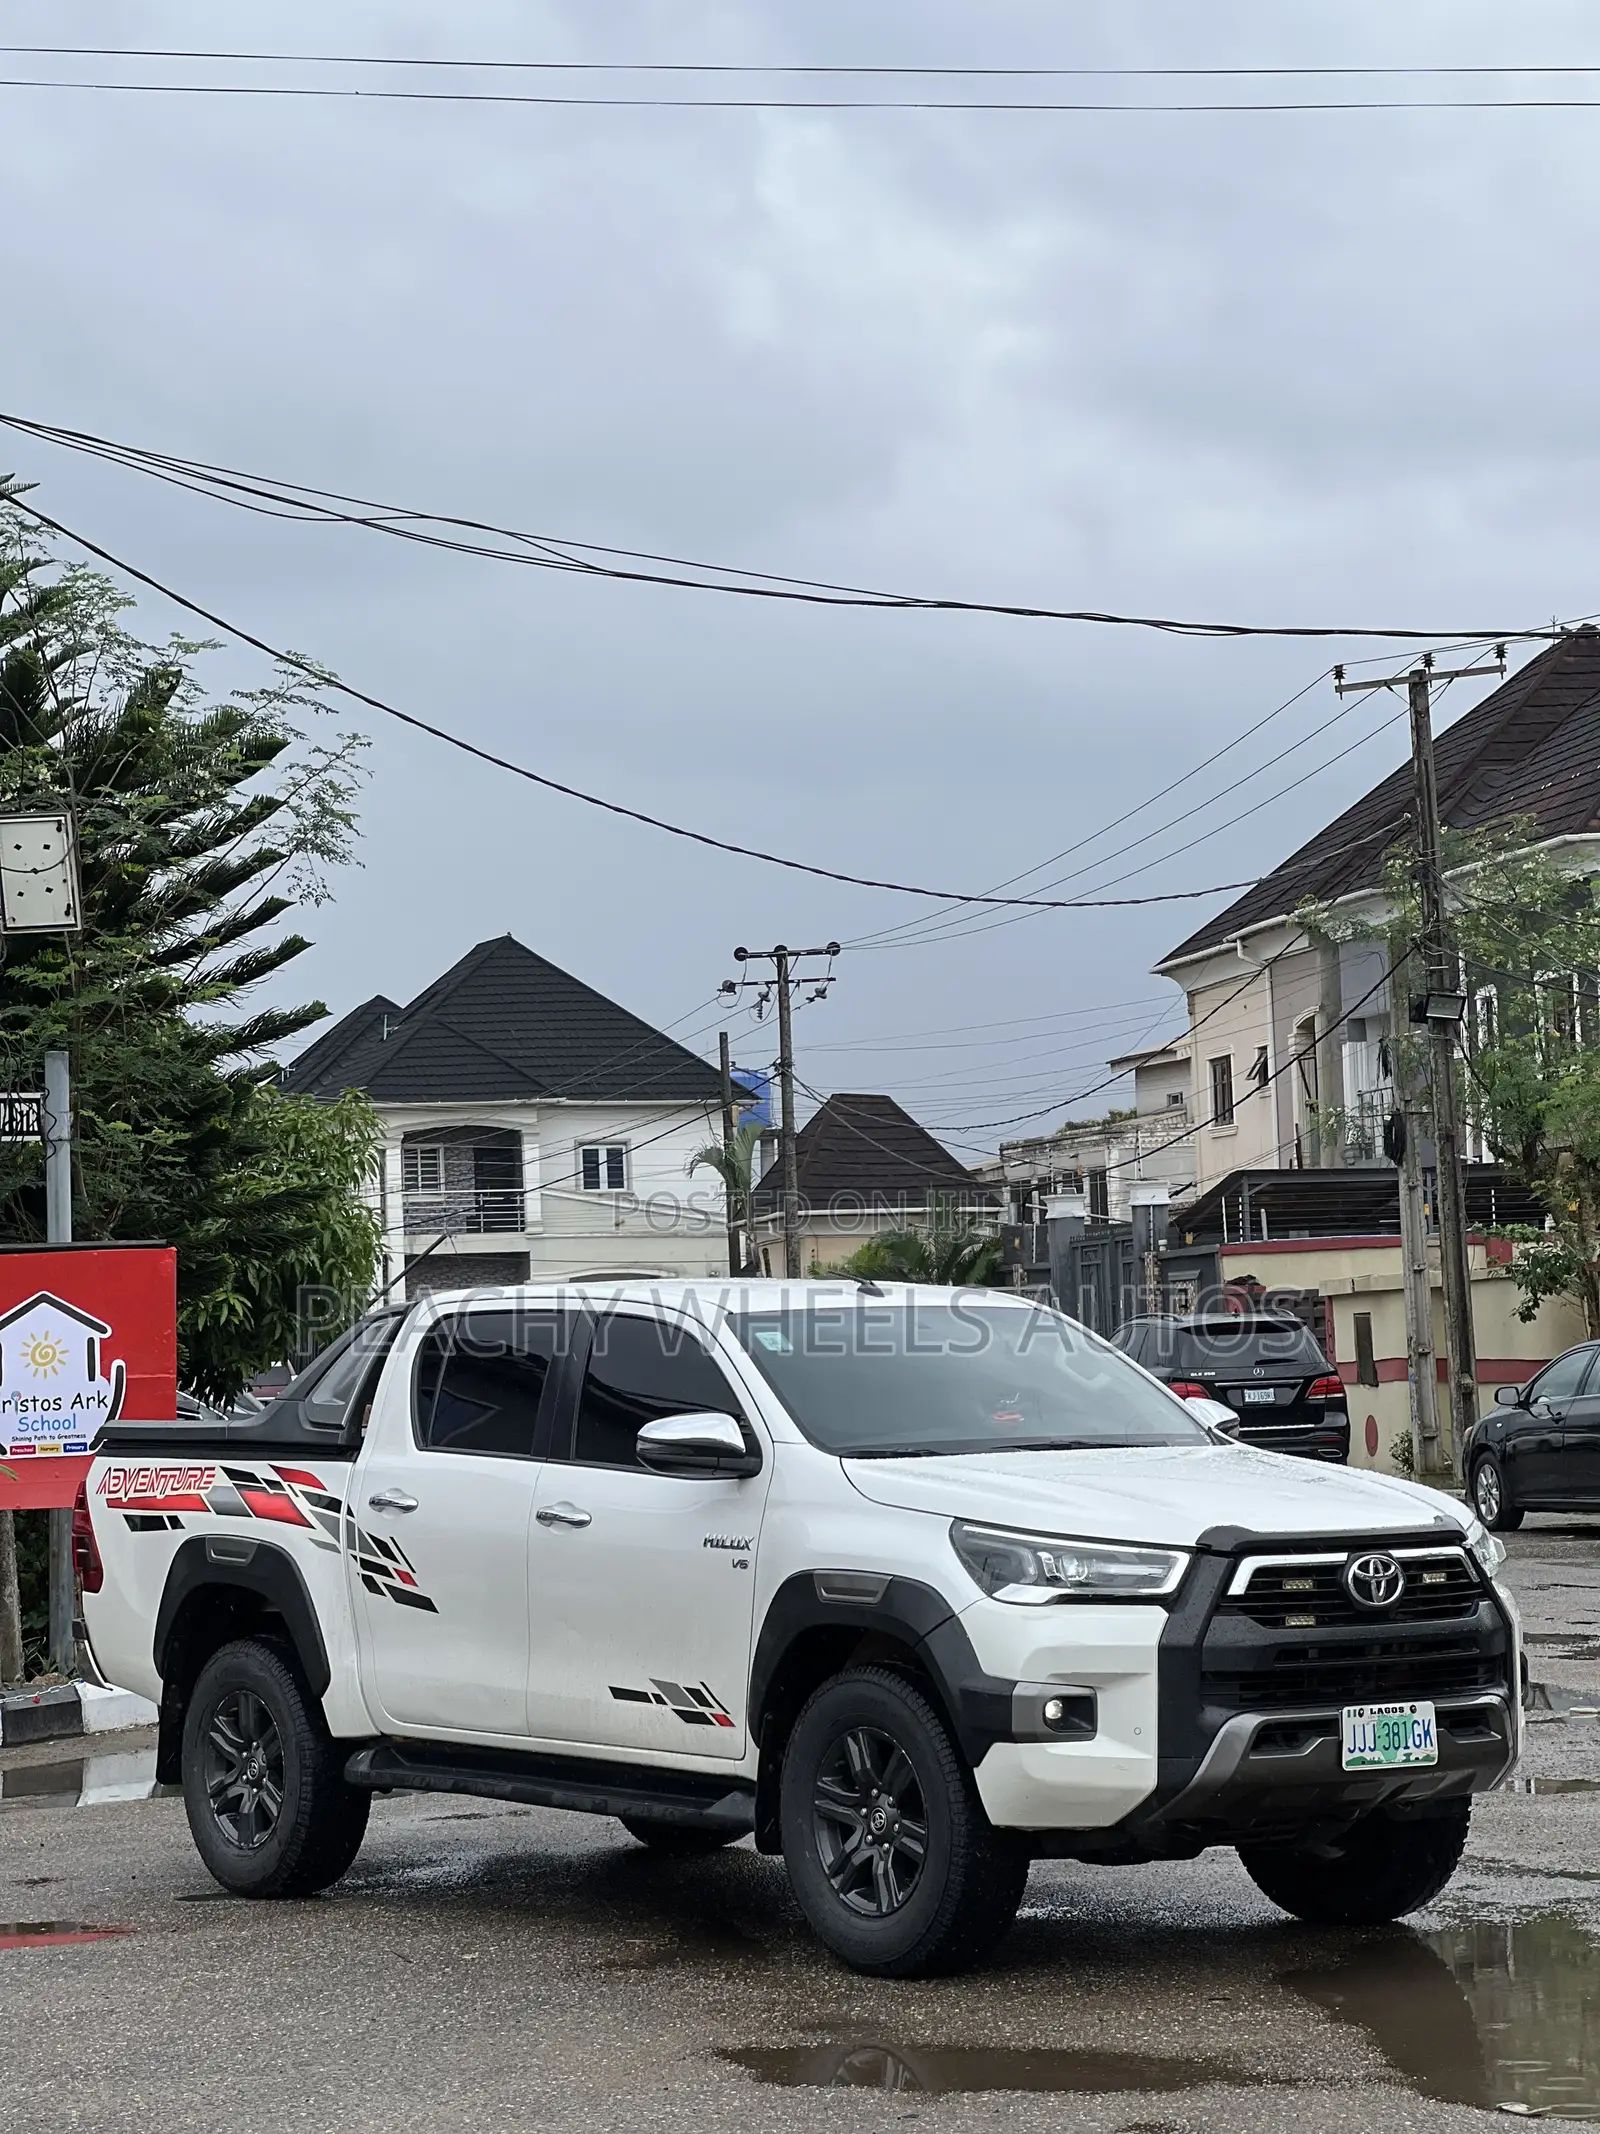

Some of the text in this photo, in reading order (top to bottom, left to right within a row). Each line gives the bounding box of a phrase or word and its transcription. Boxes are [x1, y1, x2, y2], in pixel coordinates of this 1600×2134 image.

[0, 1390, 108, 1414] ristos Ark
[18, 1413, 76, 1432] School
[11, 1435, 32, 1443] Shining
[96, 1466, 217, 1498] ADVENTURE
[703, 1533, 755, 1551] HILUX
[732, 1558, 749, 1570] V6
[1369, 1706, 1405, 1715] LAGOS
